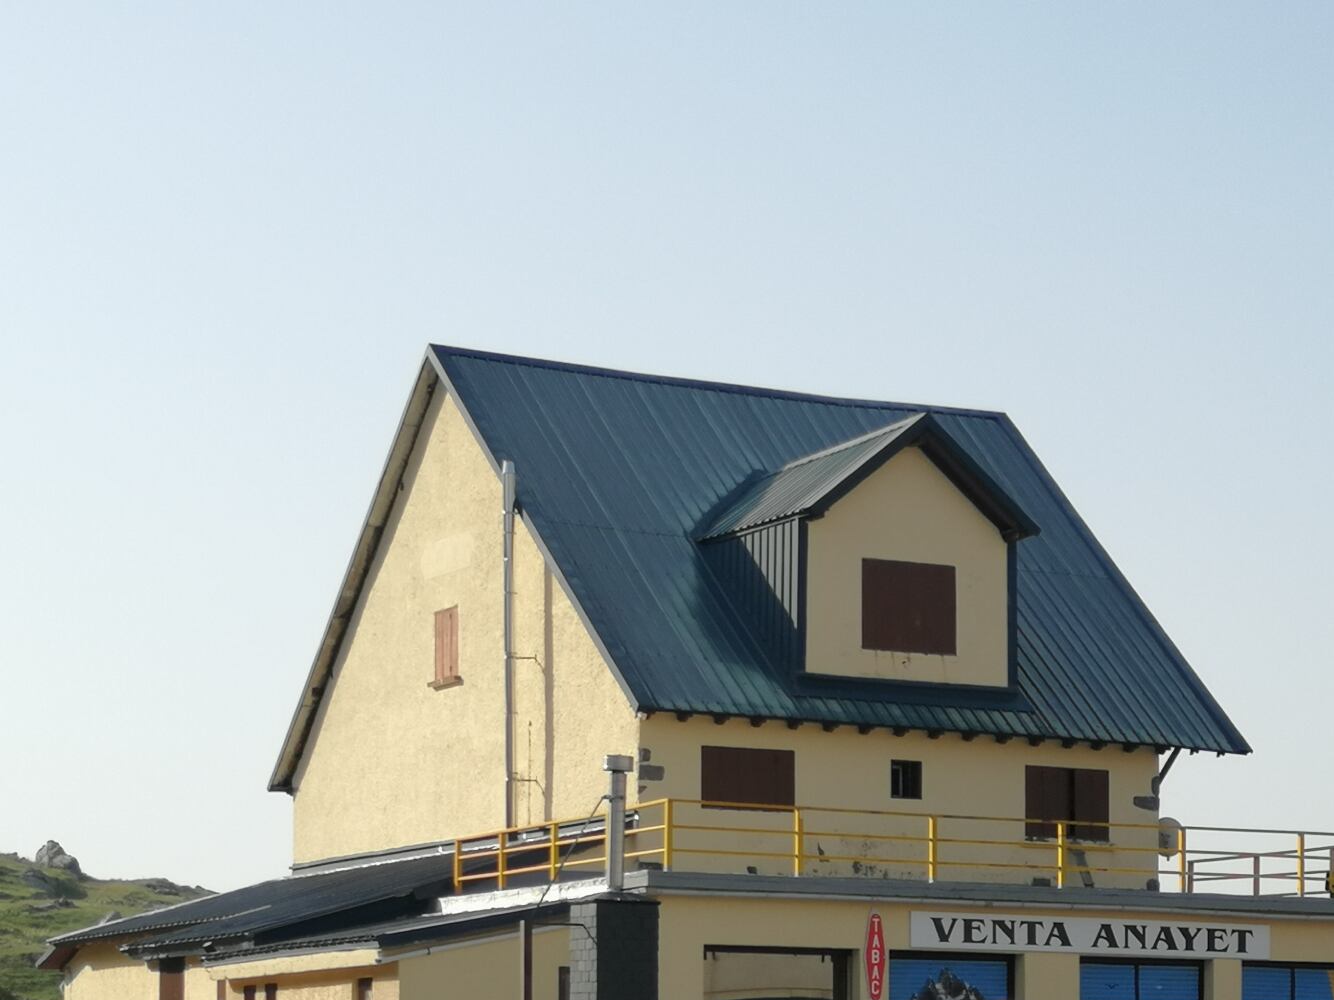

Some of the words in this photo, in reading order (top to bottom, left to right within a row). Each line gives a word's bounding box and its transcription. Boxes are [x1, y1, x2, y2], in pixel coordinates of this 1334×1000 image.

[871, 918, 881, 996] TABAC
[930, 917, 1072, 947] VENTA
[1091, 923, 1254, 954] ANAYET
